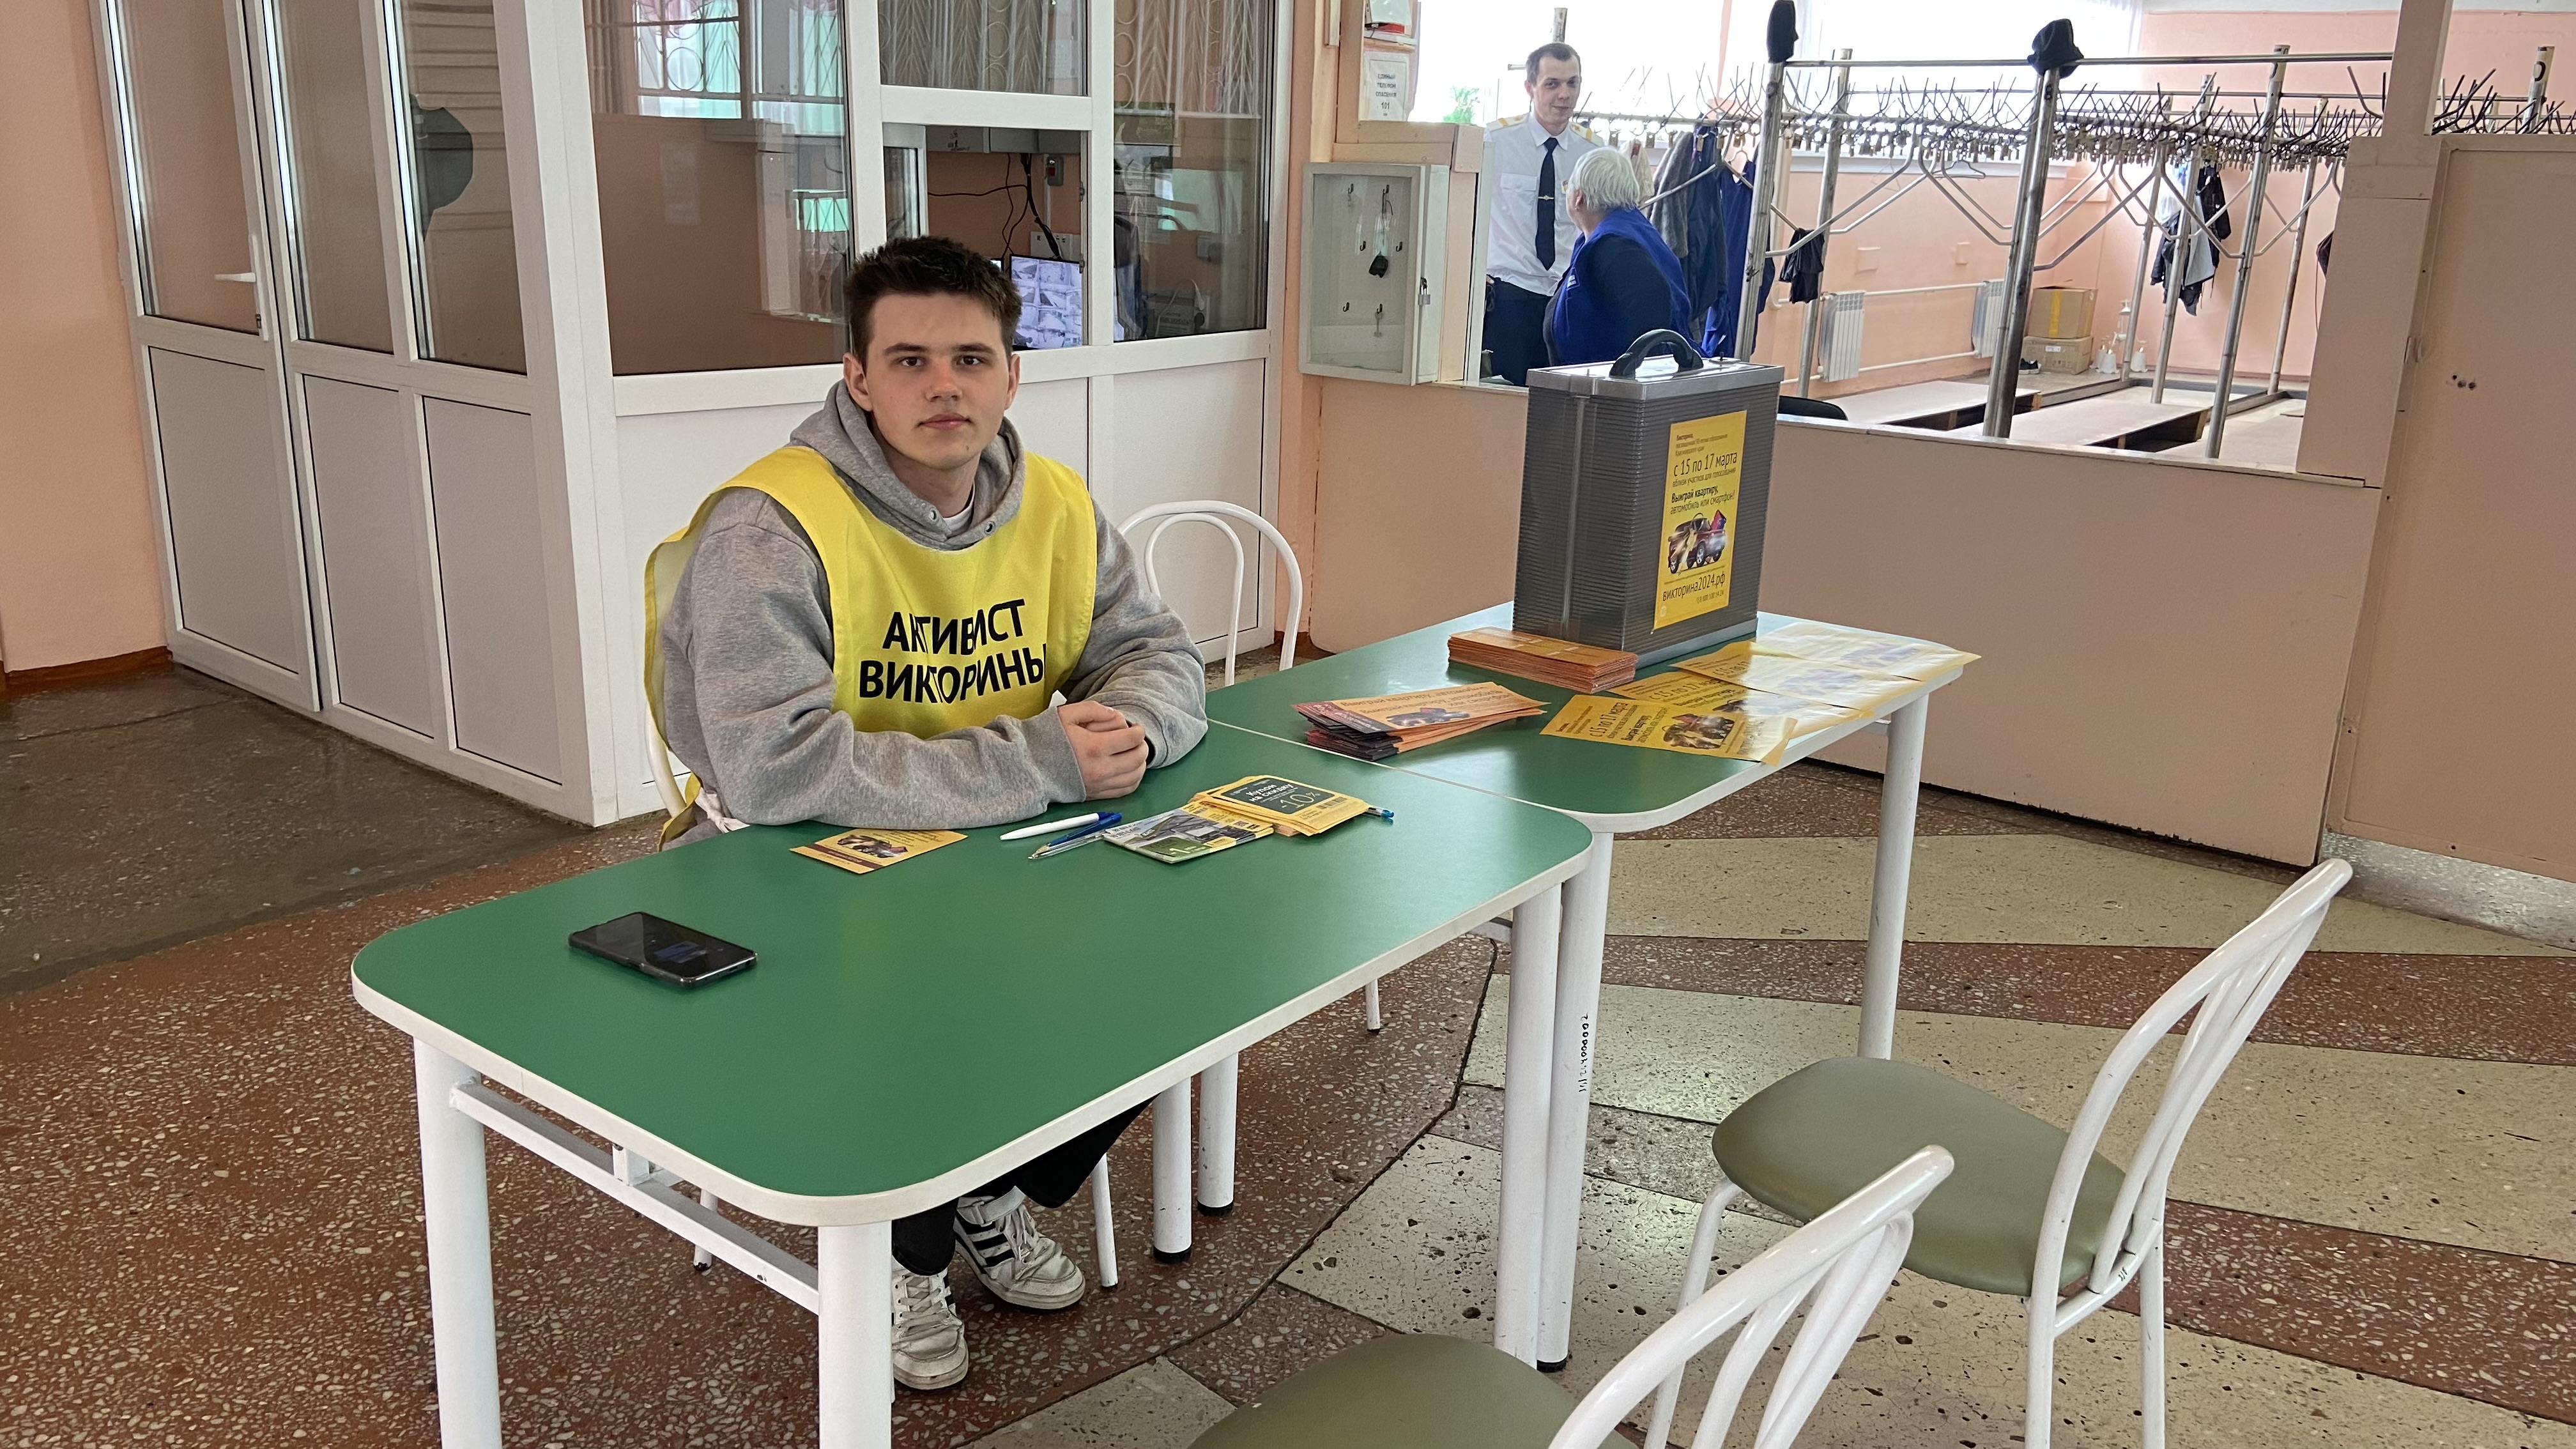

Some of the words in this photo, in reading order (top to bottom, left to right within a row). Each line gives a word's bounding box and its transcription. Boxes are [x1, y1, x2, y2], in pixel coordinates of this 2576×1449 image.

[1674, 464, 1678, 477] с
[1680, 458, 1690, 475] 15
[1692, 459, 1702, 473] по
[1704, 453, 1715, 470] 17
[1715, 452, 1737, 470] марта
[1671, 489, 1694, 503] Выиграй
[1662, 571, 1726, 602] викторина2024.рф
[1245, 784, 1277, 796] Купон
[1261, 783, 1294, 797] скидку
[1280, 792, 1321, 809] -10%
